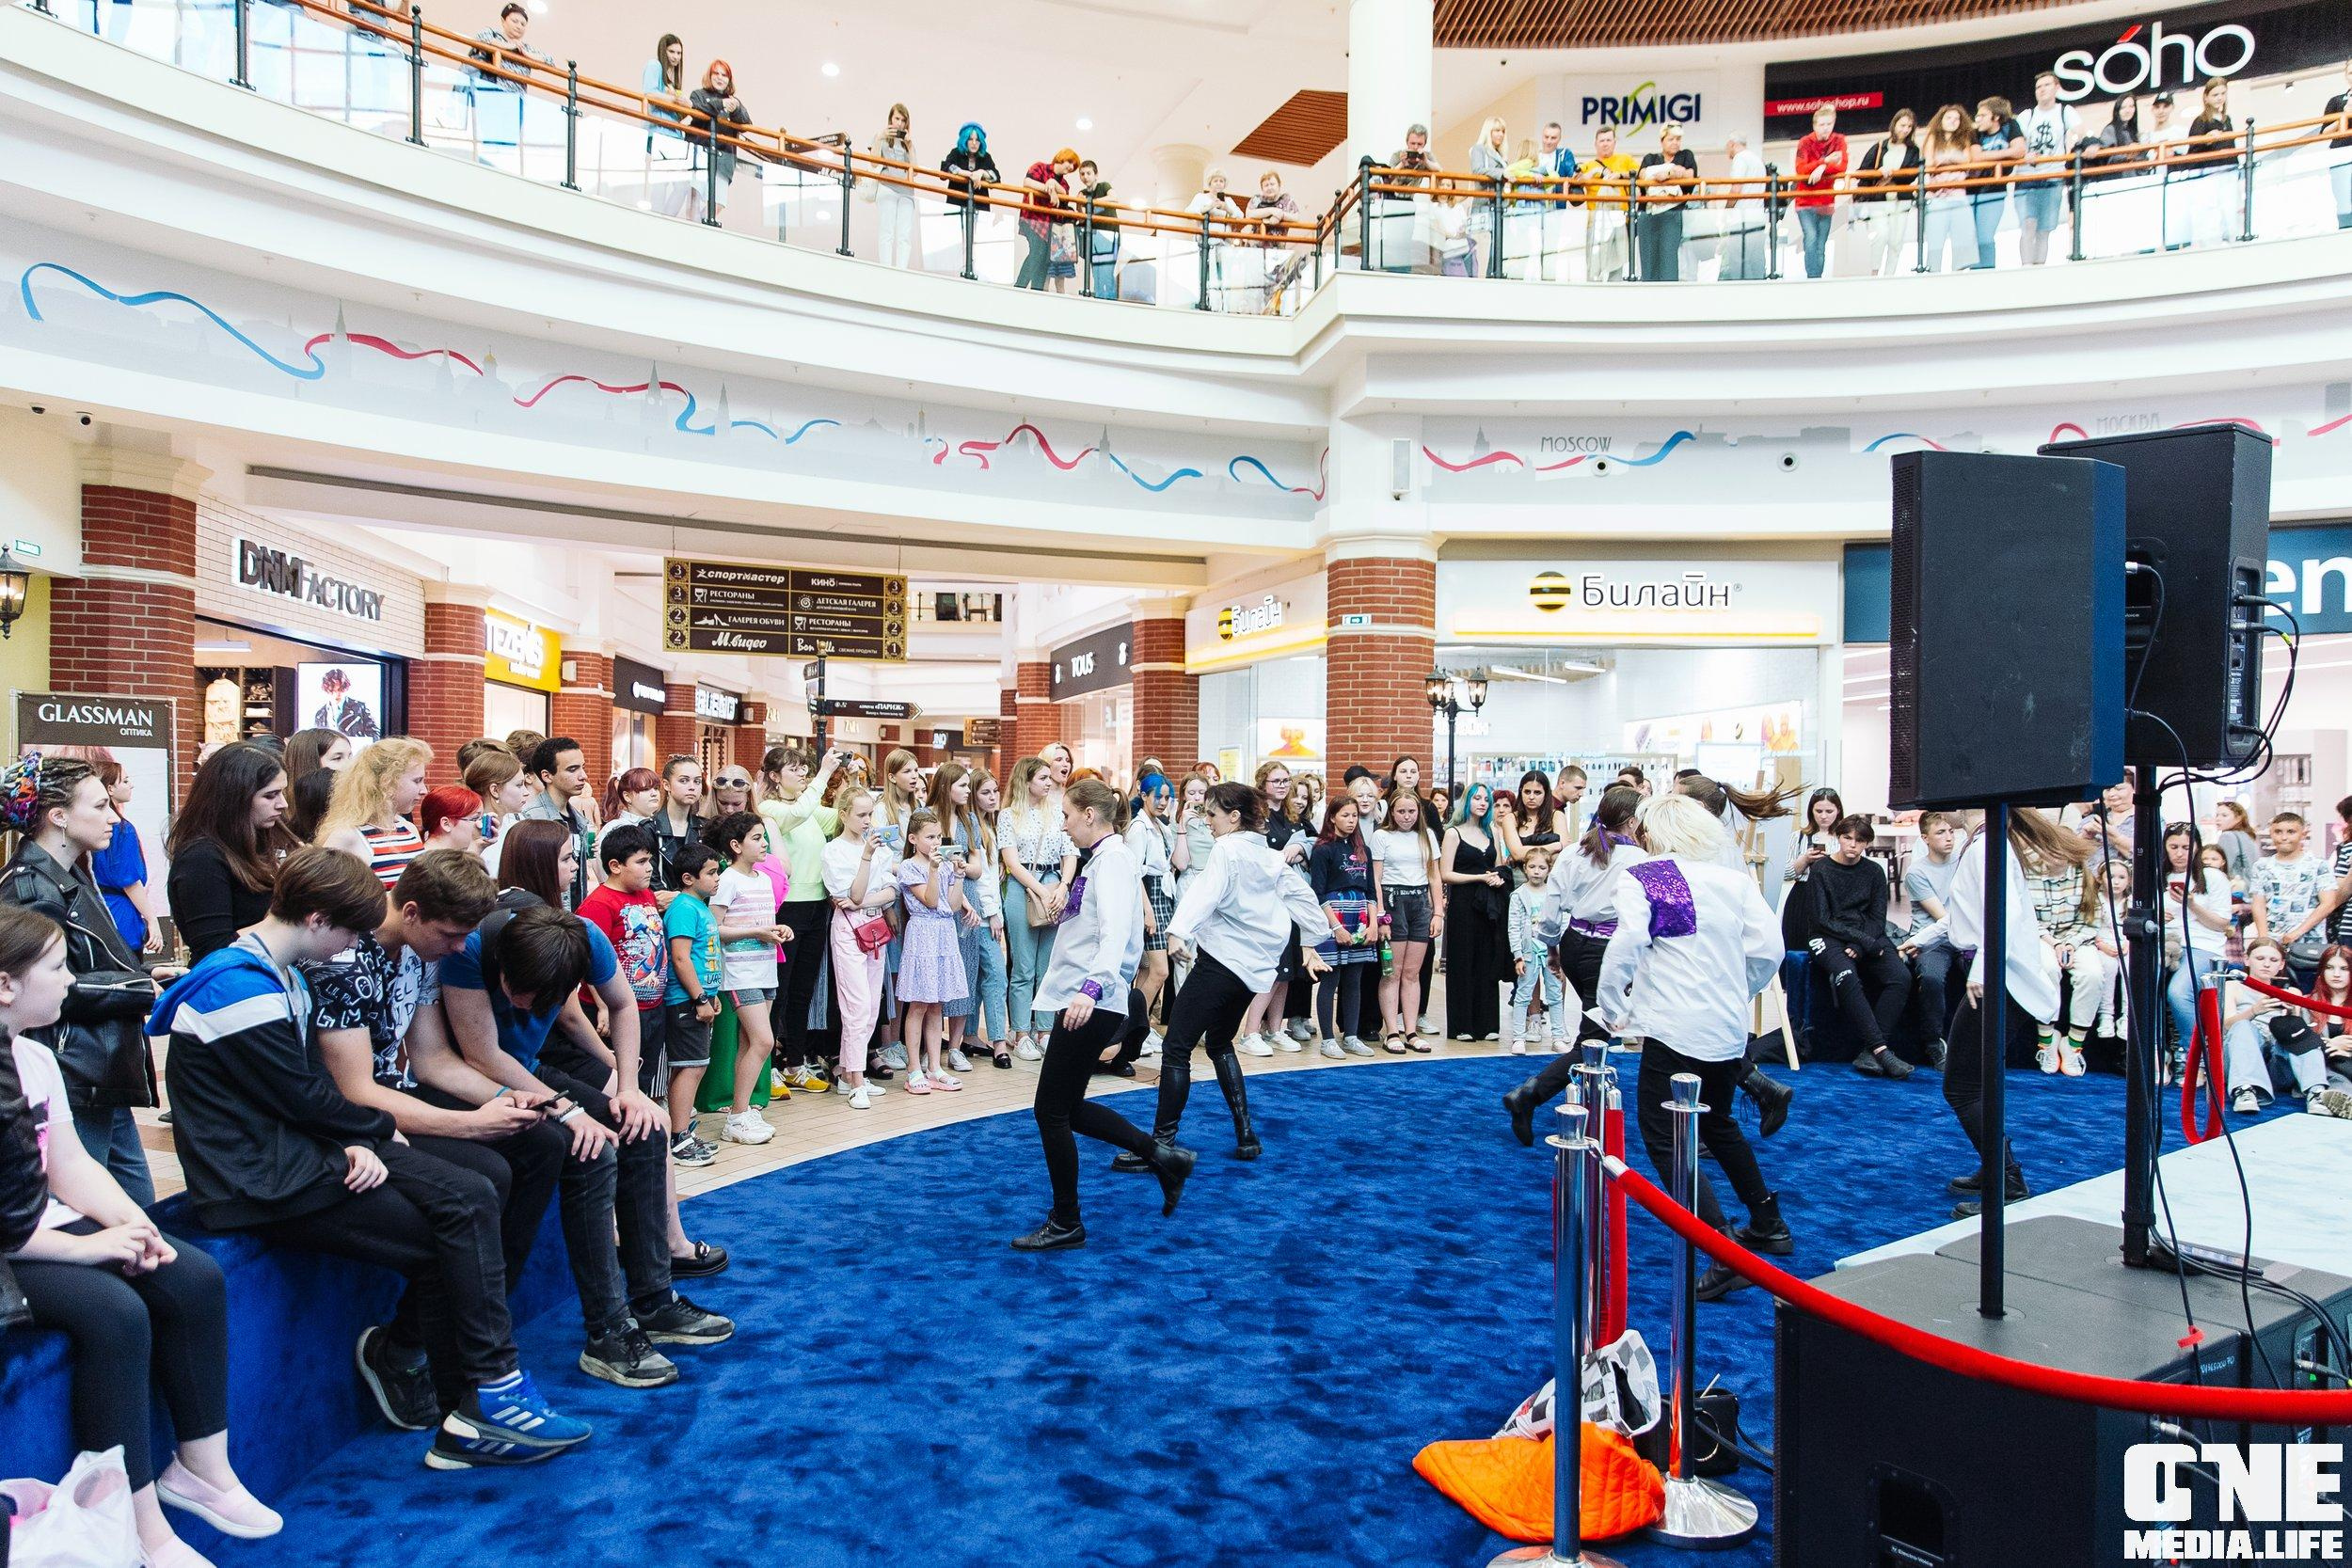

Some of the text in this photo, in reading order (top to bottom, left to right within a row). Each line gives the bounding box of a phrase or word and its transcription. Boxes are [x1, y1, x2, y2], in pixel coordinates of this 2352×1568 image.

[1581, 93, 1701, 125] PRIMIGI
[1540, 436, 1612, 452] MOSCOW
[675, 564, 682, 575] 3
[707, 569, 785, 584] спортмастер
[675, 585, 682, 596] 3
[892, 580, 898, 591] 3
[1582, 573, 1731, 609] Билайн
[709, 590, 755, 600] РЕСТОРАНЫ
[816, 597, 877, 608] ДЕТСКАЯ ГАЛЕРЕЯ
[892, 601, 898, 612] 3
[675, 608, 681, 620] 2
[1232, 595, 1282, 637] Билайн
[728, 615, 758, 625] ГАЛЕРЕЯ
[809, 617, 851, 626] РЕСТОРАНЫ
[892, 622, 898, 632] 2
[675, 630, 681, 641] 2
[711, 631, 768, 651] М.видео
[796, 638, 815, 652] Bon
[1072, 652, 1093, 677] TOUS
[39, 704, 152, 727] GLASSMAN
[119, 727, 153, 737] ОПТИКА
